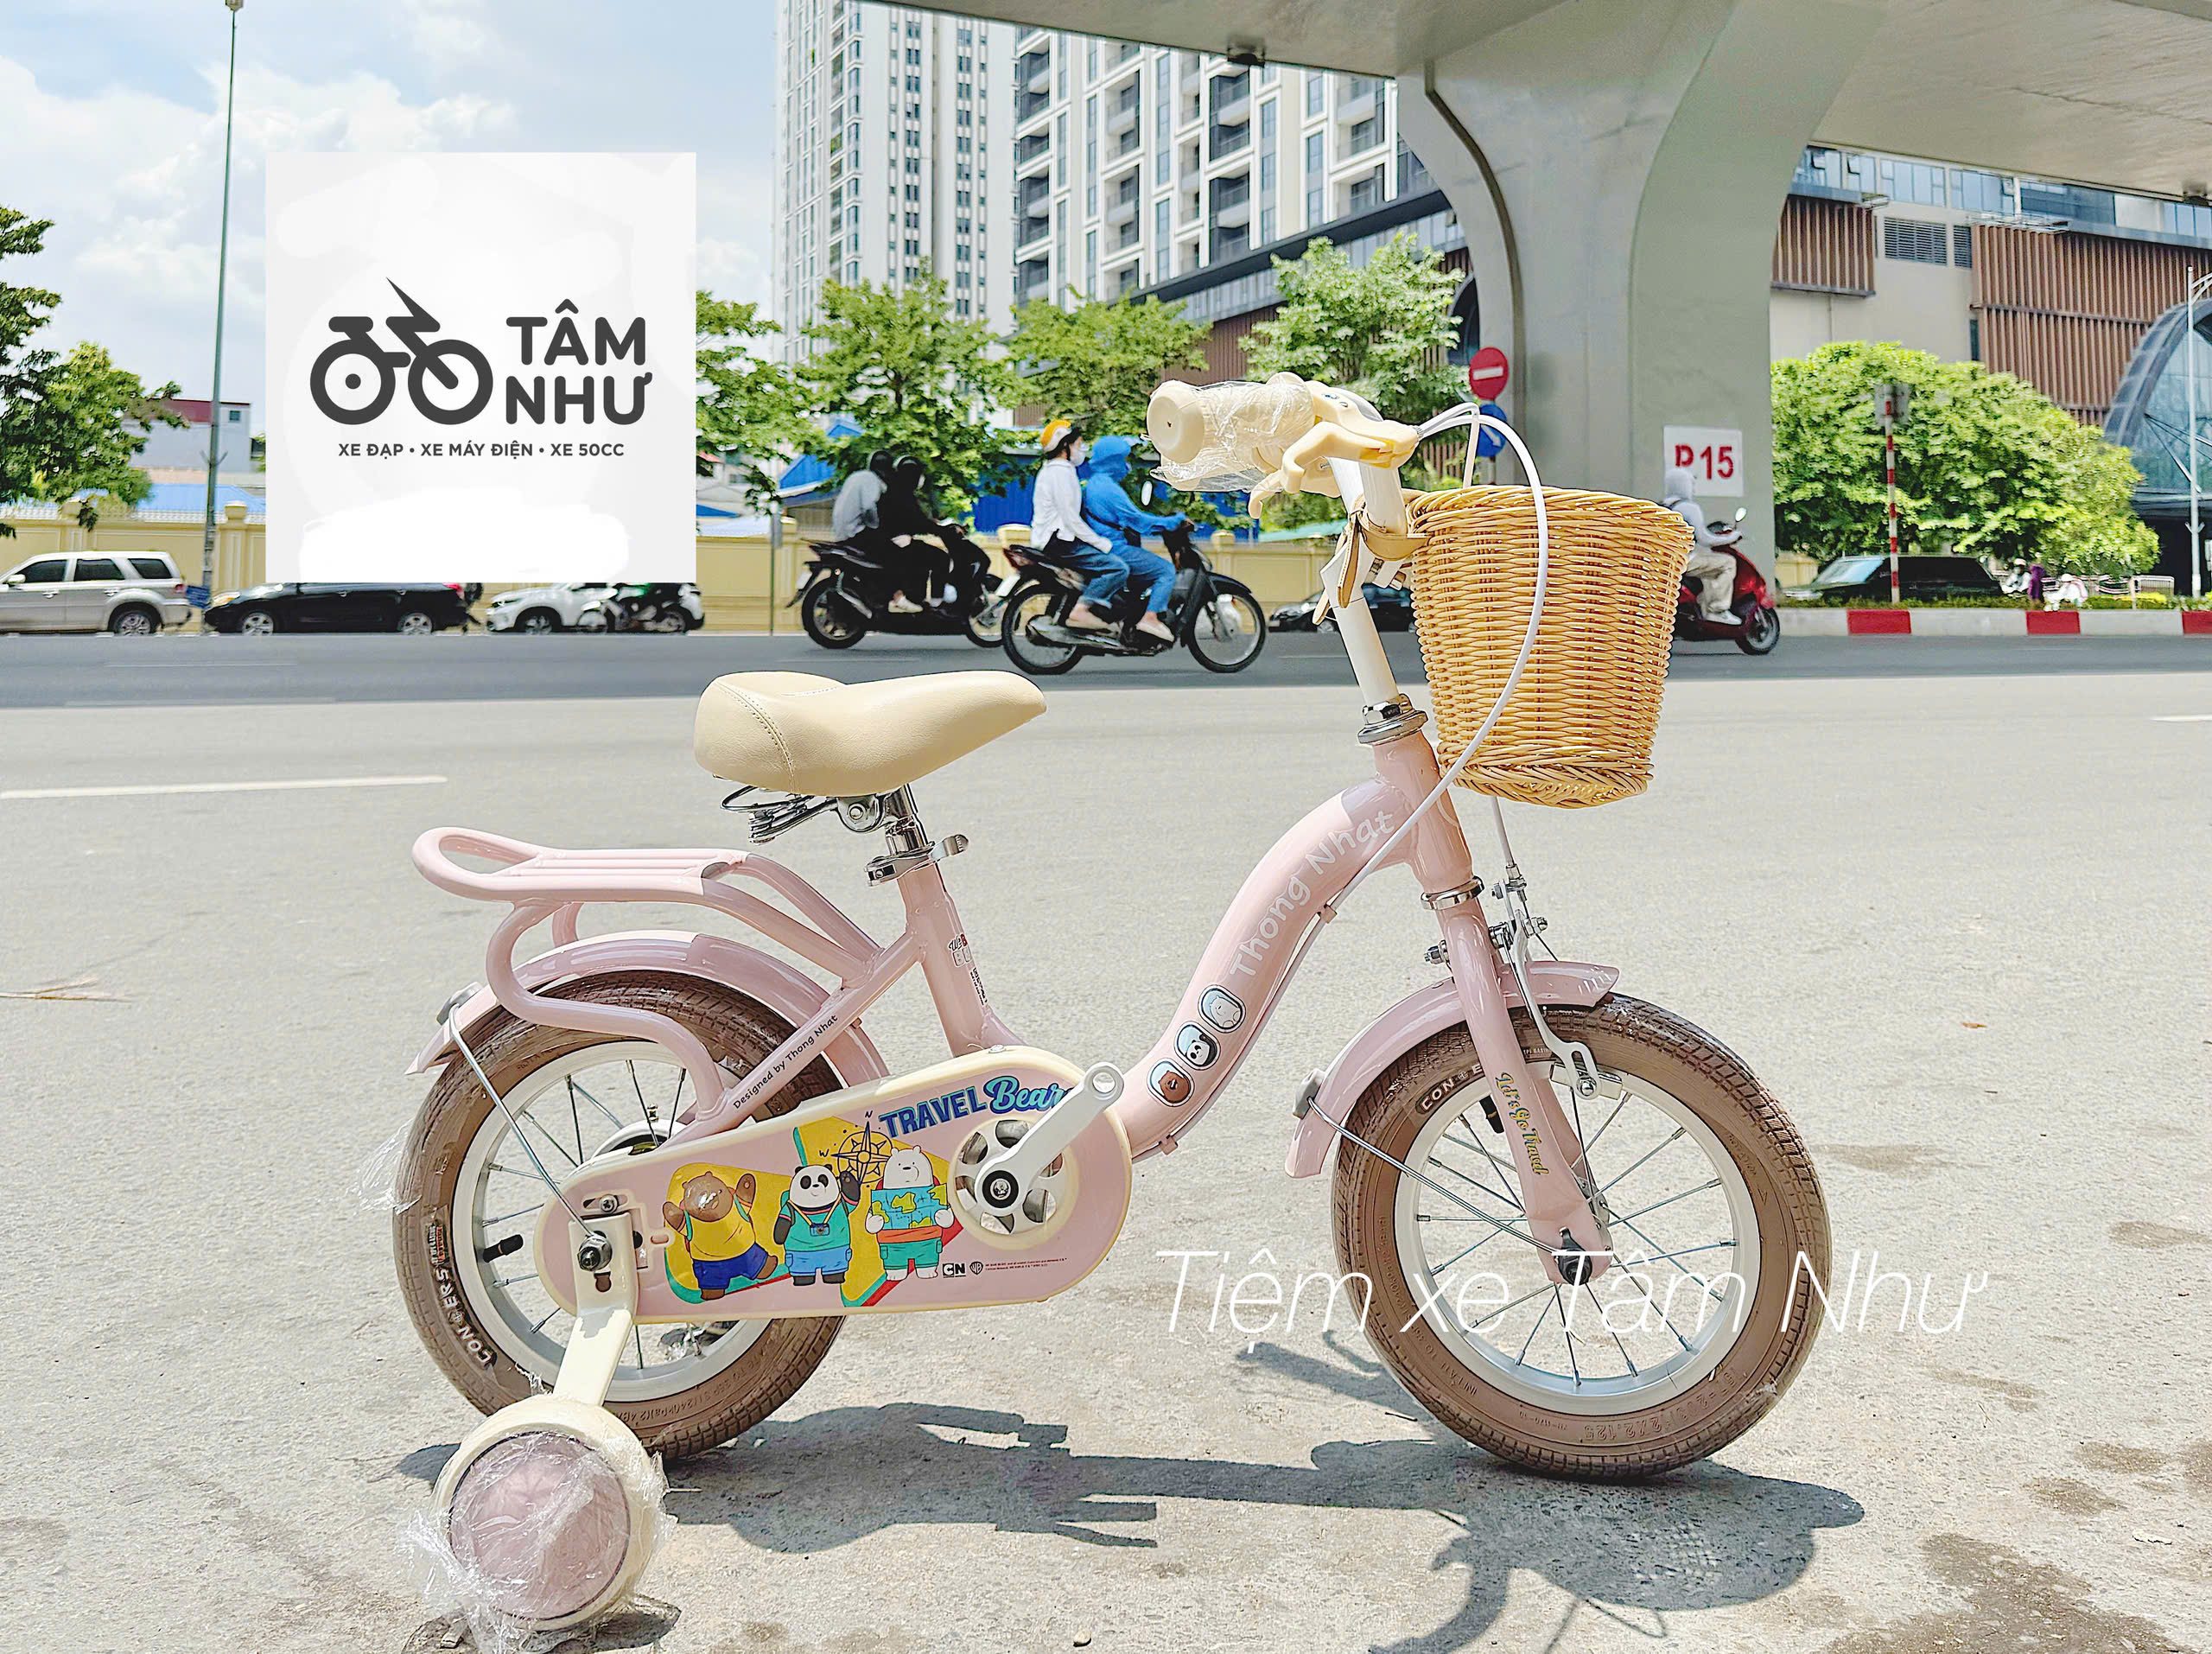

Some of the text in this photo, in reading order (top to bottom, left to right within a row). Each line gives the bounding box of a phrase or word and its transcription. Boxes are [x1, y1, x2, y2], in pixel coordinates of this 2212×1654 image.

[1230, 810, 1396, 976] Thong Nhat
[733, 1015, 838, 1109] Designed by Thong Nhat
[865, 1110, 874, 1118] N
[878, 1075, 1074, 1138] TRAVEL Bear
[818, 1148, 830, 1157] W
[942, 1263, 966, 1276] CN
